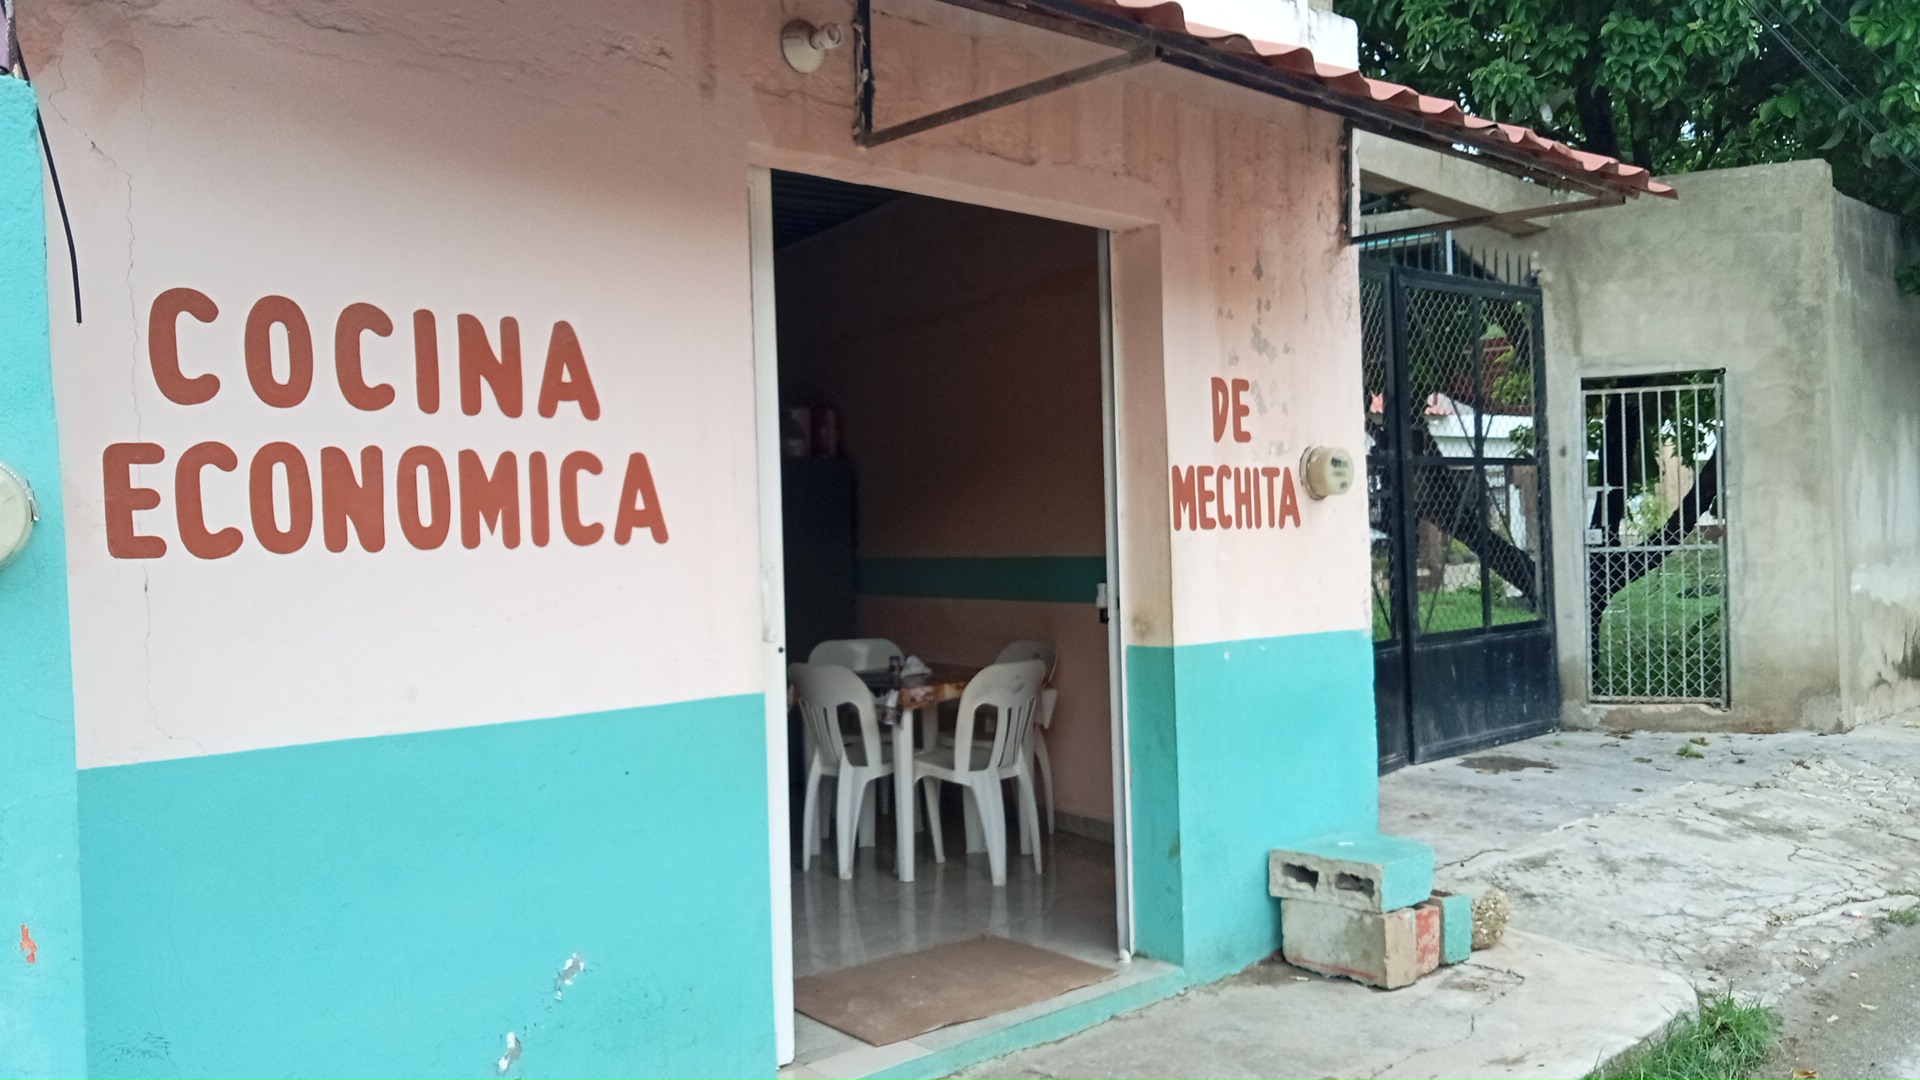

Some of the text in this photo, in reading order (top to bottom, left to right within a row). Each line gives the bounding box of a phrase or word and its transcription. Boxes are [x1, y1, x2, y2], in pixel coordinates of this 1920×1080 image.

[148, 287, 601, 421] COCINA
[1211, 376, 1252, 443] DE
[103, 441, 669, 559] ECONOMICA
[1172, 464, 1301, 531] MECHITA
